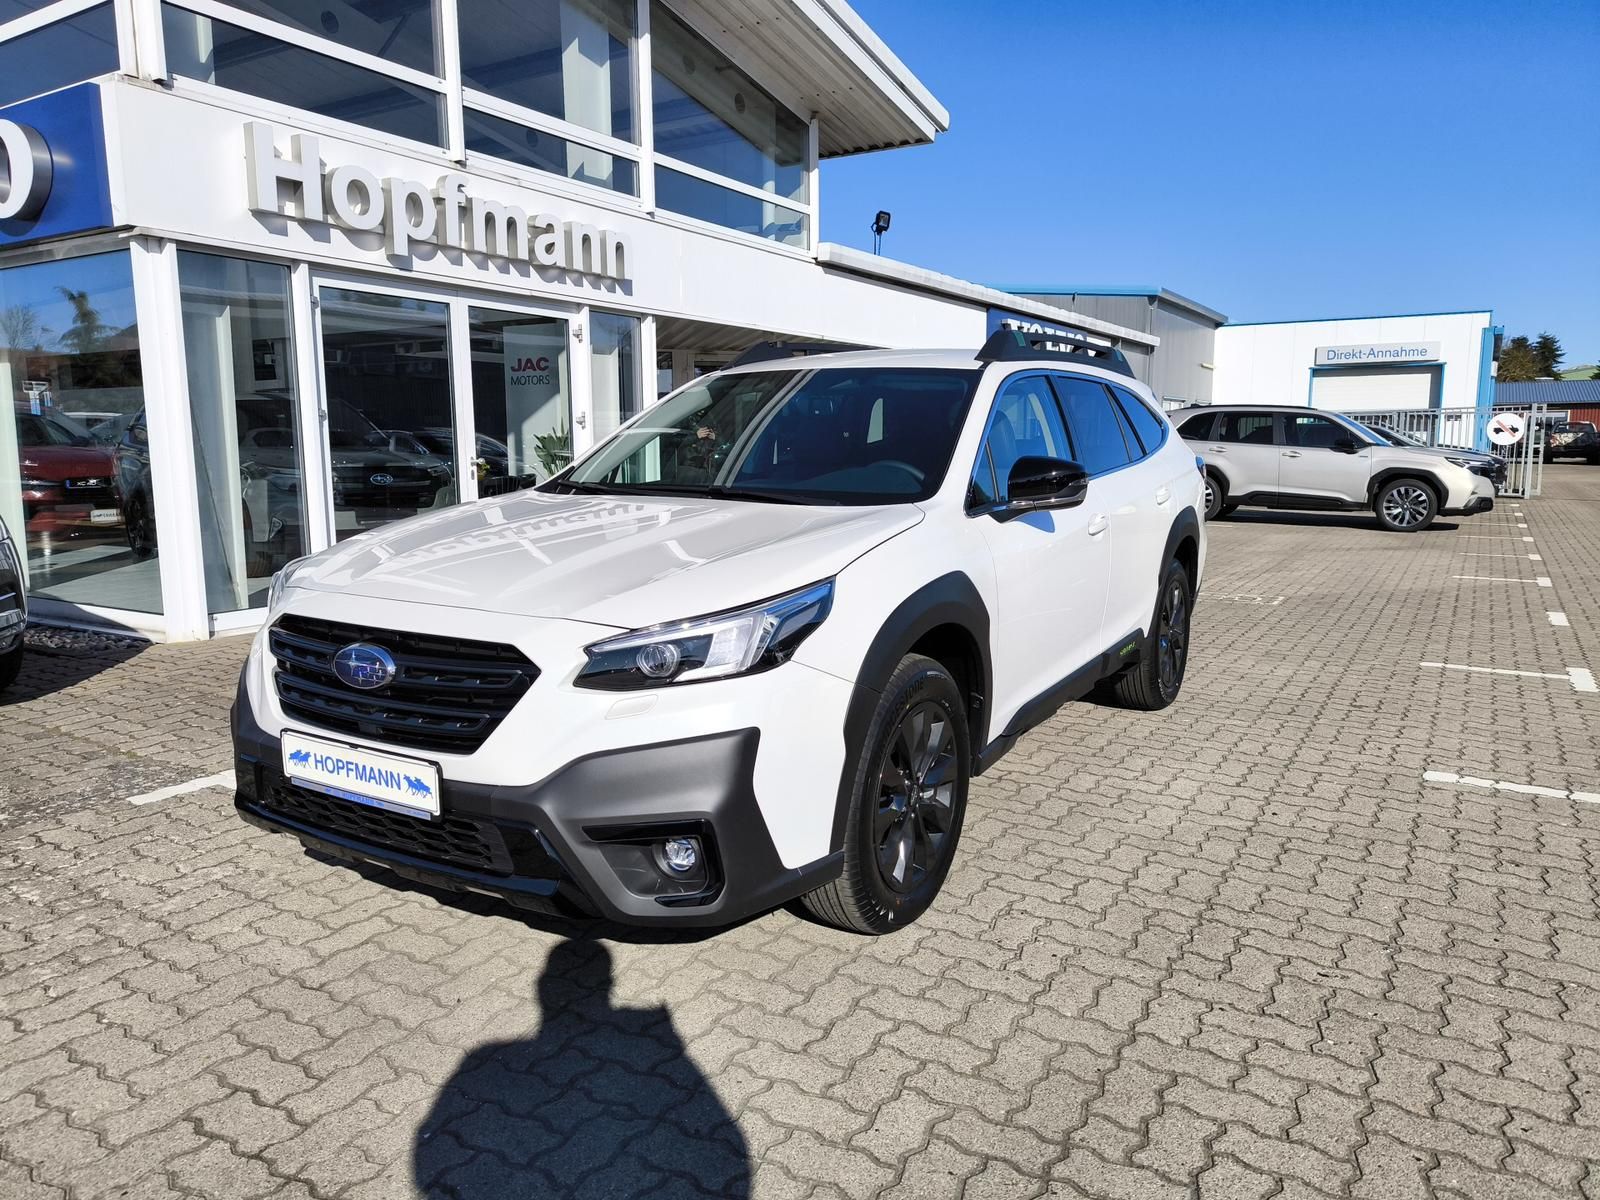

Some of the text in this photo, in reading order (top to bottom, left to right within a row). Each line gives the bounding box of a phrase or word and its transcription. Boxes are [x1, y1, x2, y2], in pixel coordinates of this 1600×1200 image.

[244, 121, 632, 280] Hopfmann
[1326, 345, 1429, 361] Direkt-Annahme
[510, 357, 550, 372] JAC
[510, 374, 551, 386] MOTORS
[313, 752, 402, 791] HOPFMANN
